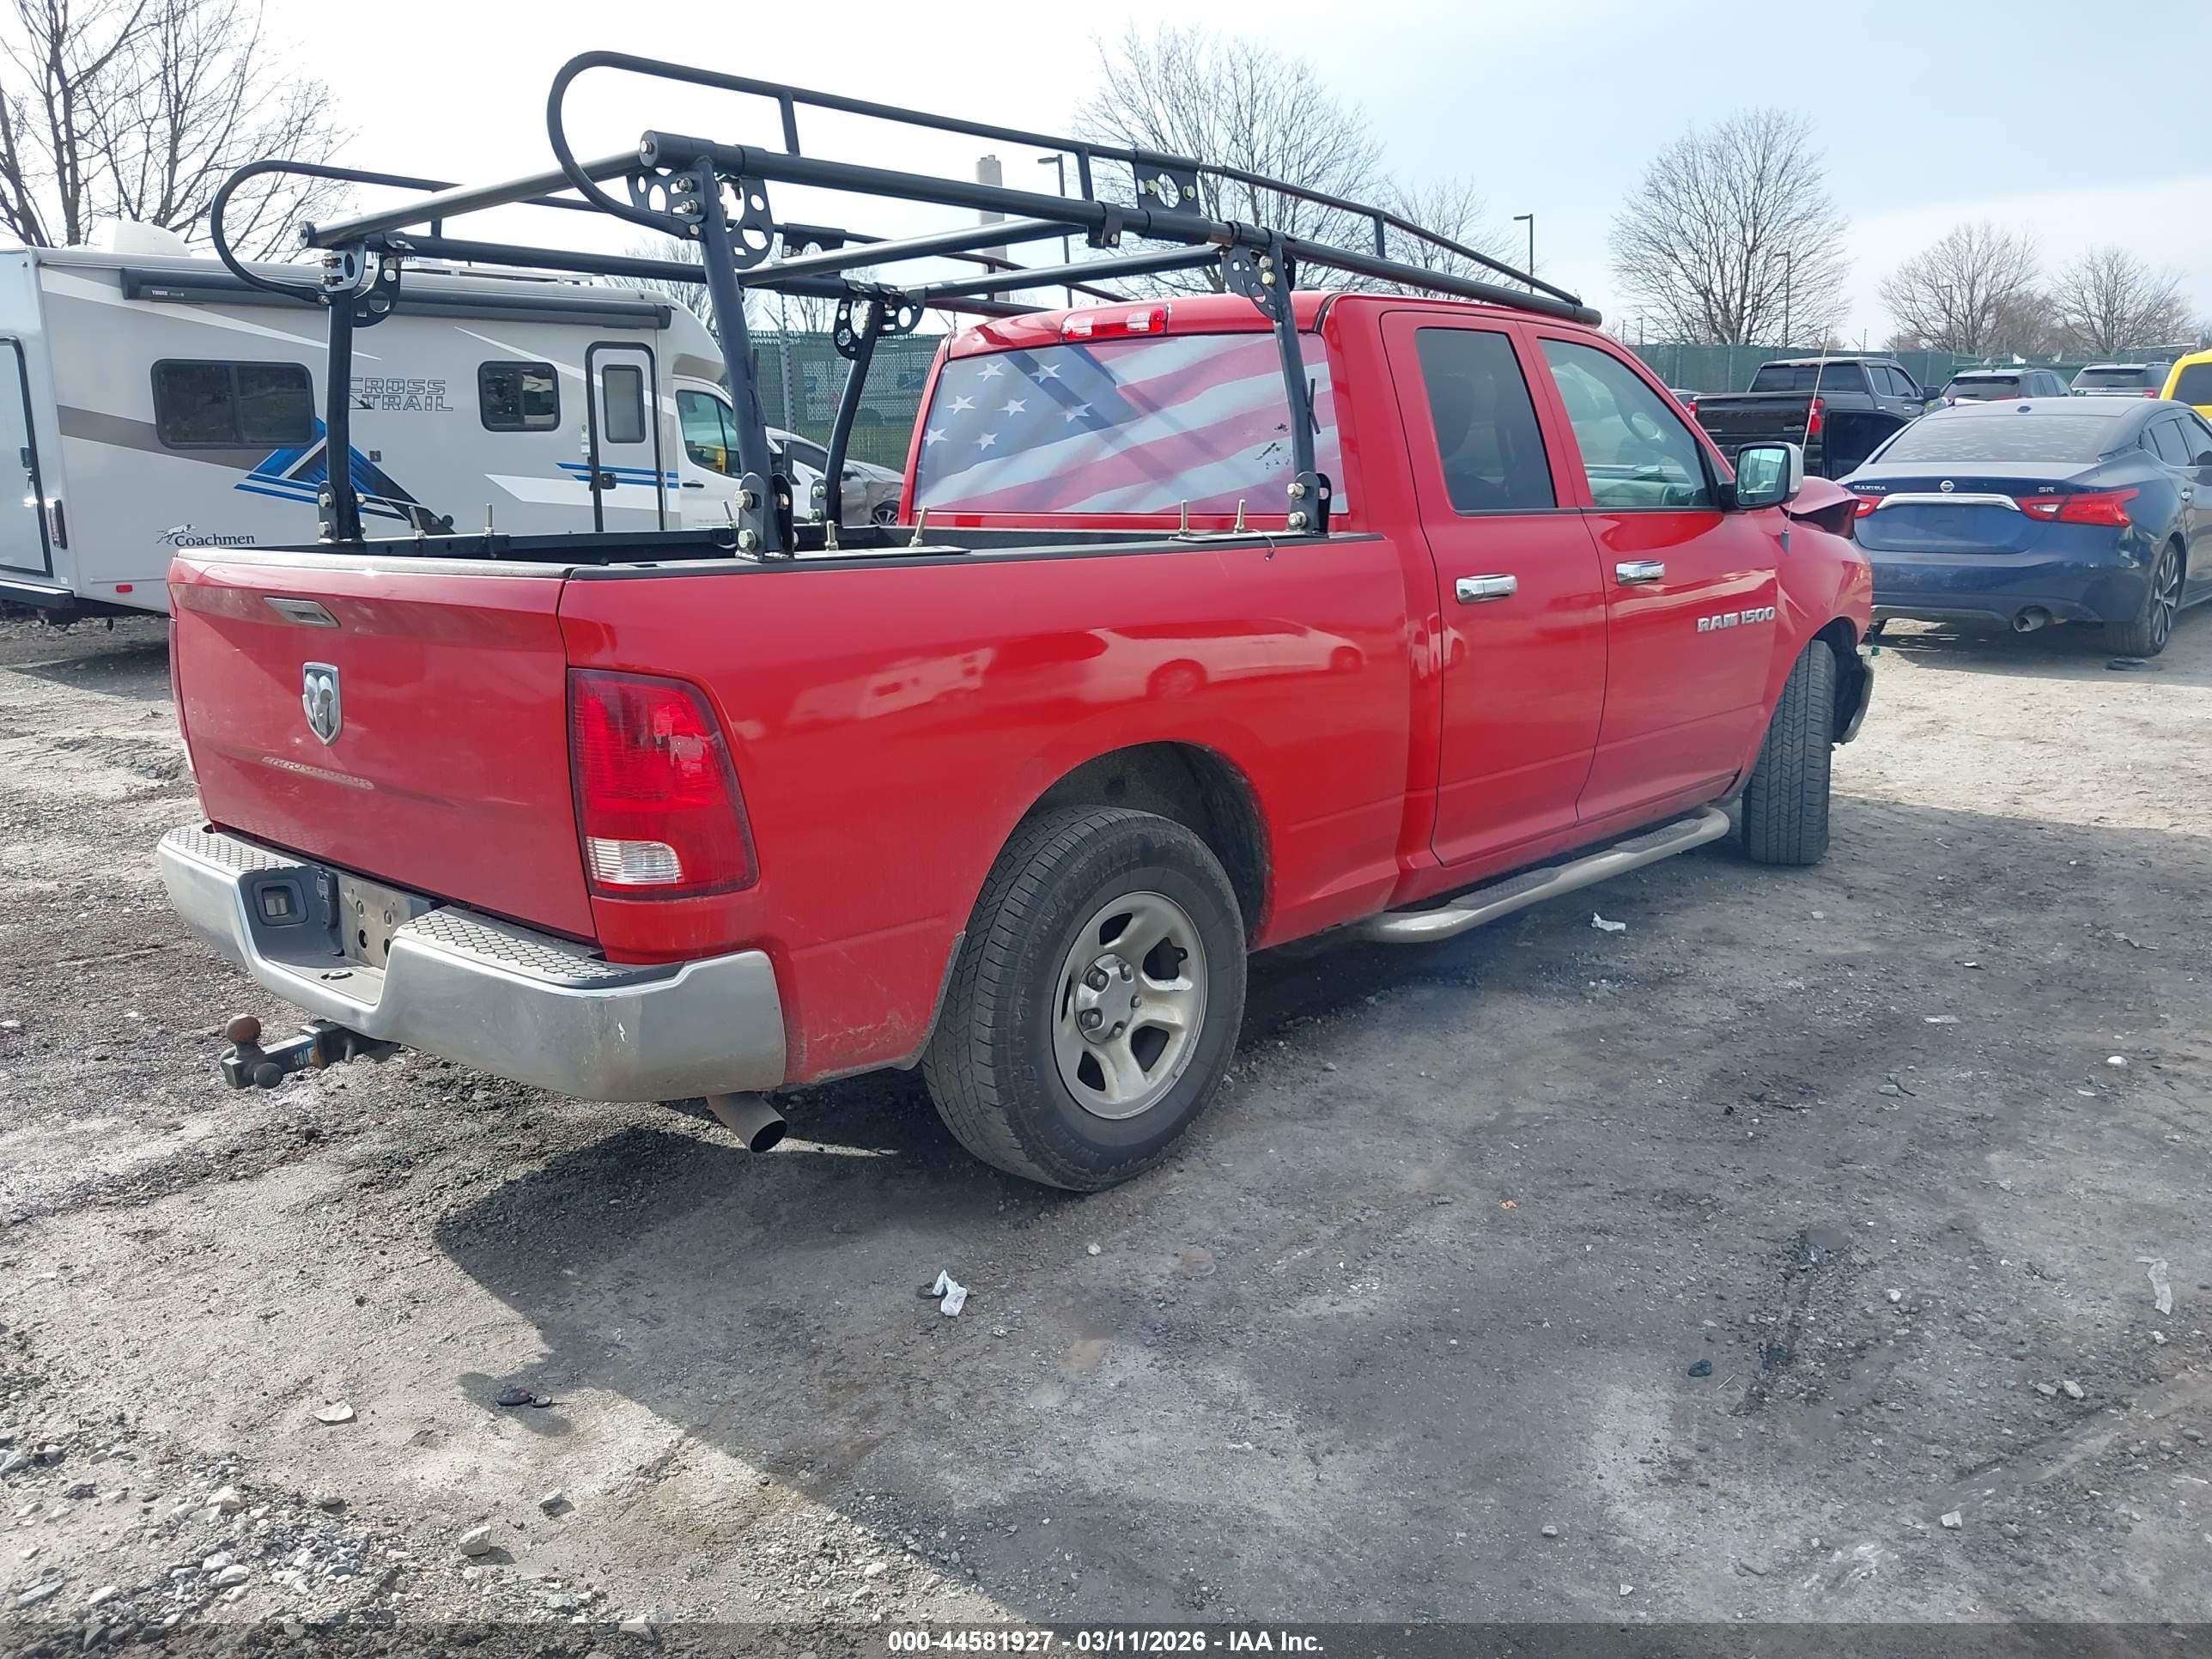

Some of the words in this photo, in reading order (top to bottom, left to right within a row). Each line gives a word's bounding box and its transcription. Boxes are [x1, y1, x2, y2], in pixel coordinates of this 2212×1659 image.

[362, 394, 454, 411] TRAIL
[174, 533, 255, 547] Coachmen
[1697, 612, 1739, 633] RAM
[1741, 606, 1776, 625] 1500
